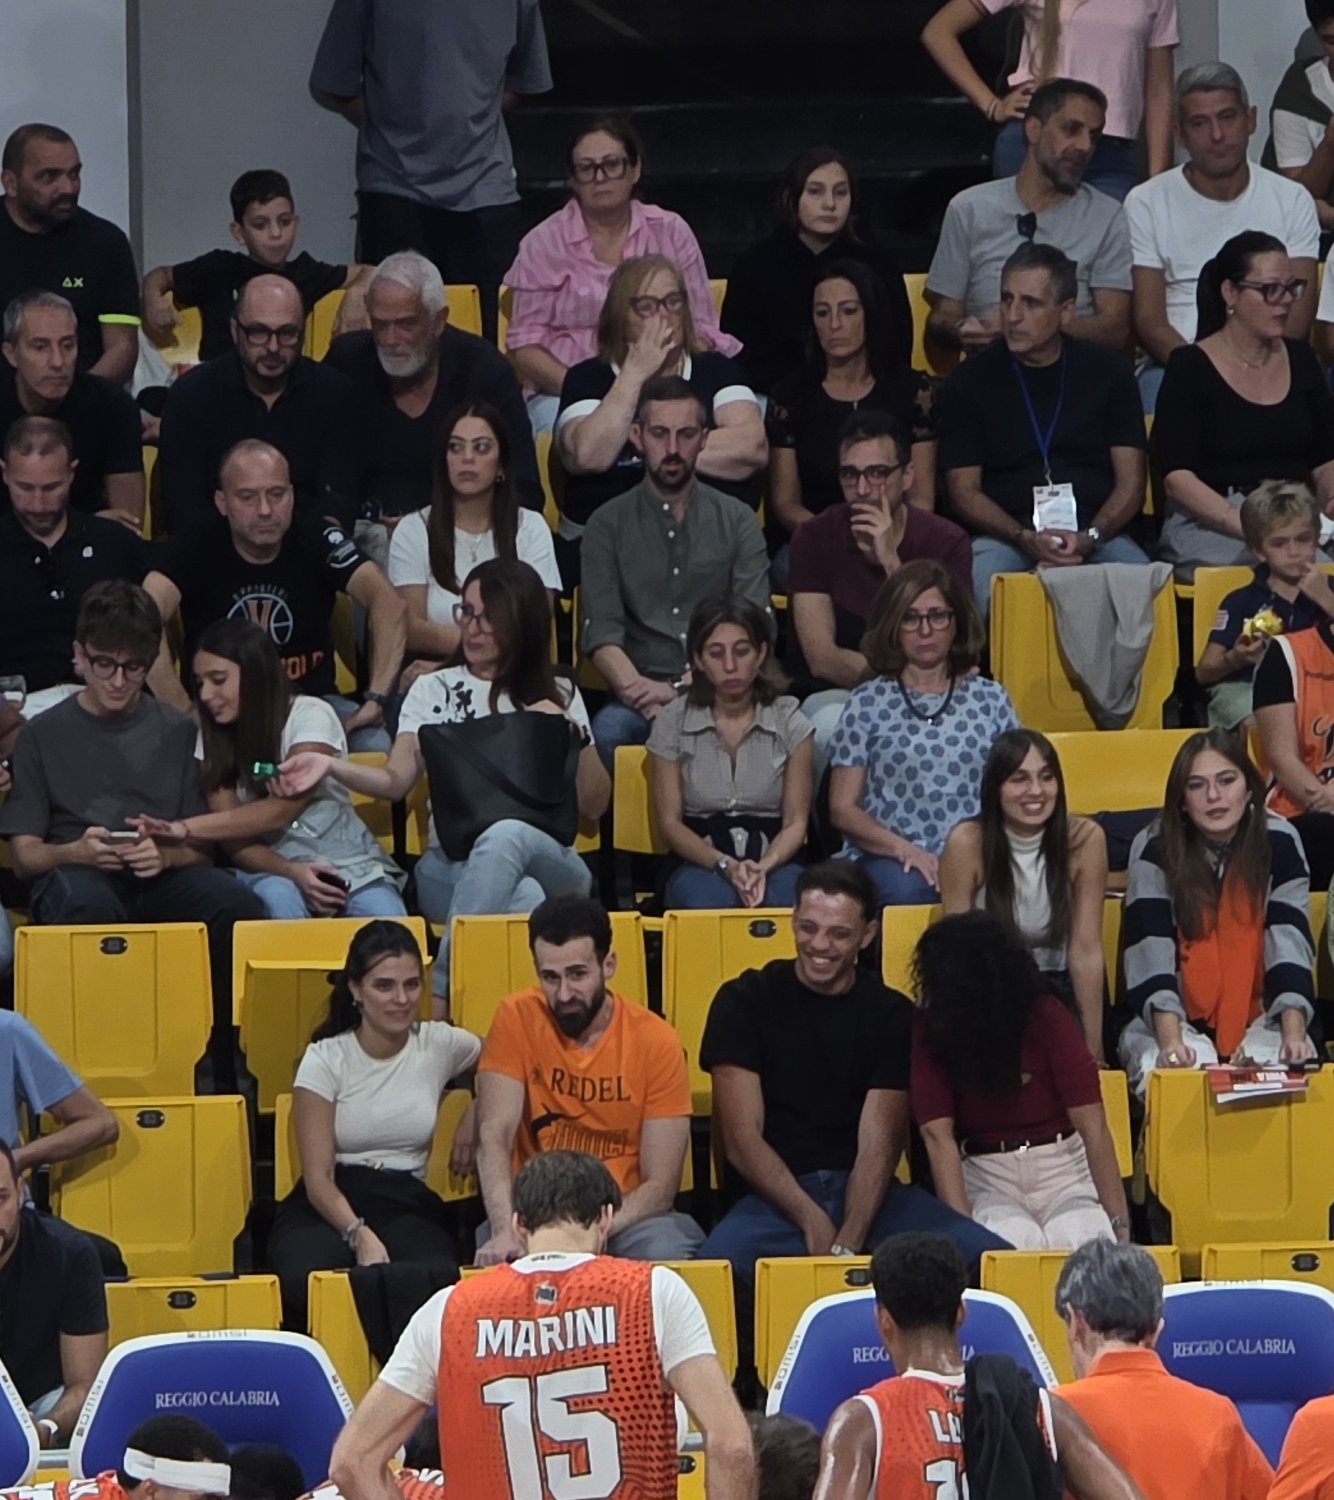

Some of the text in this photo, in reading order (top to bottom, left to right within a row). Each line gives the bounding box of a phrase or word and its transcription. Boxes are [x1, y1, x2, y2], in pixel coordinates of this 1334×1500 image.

[550, 1067, 632, 1104] REDEL
[474, 1305, 617, 1359] MARINI
[852, 1346, 891, 1364] REGG
[1173, 1338, 1296, 1358] REGGIO CALABRIA
[155, 1390, 280, 1410] REGGIO CALABRIA
